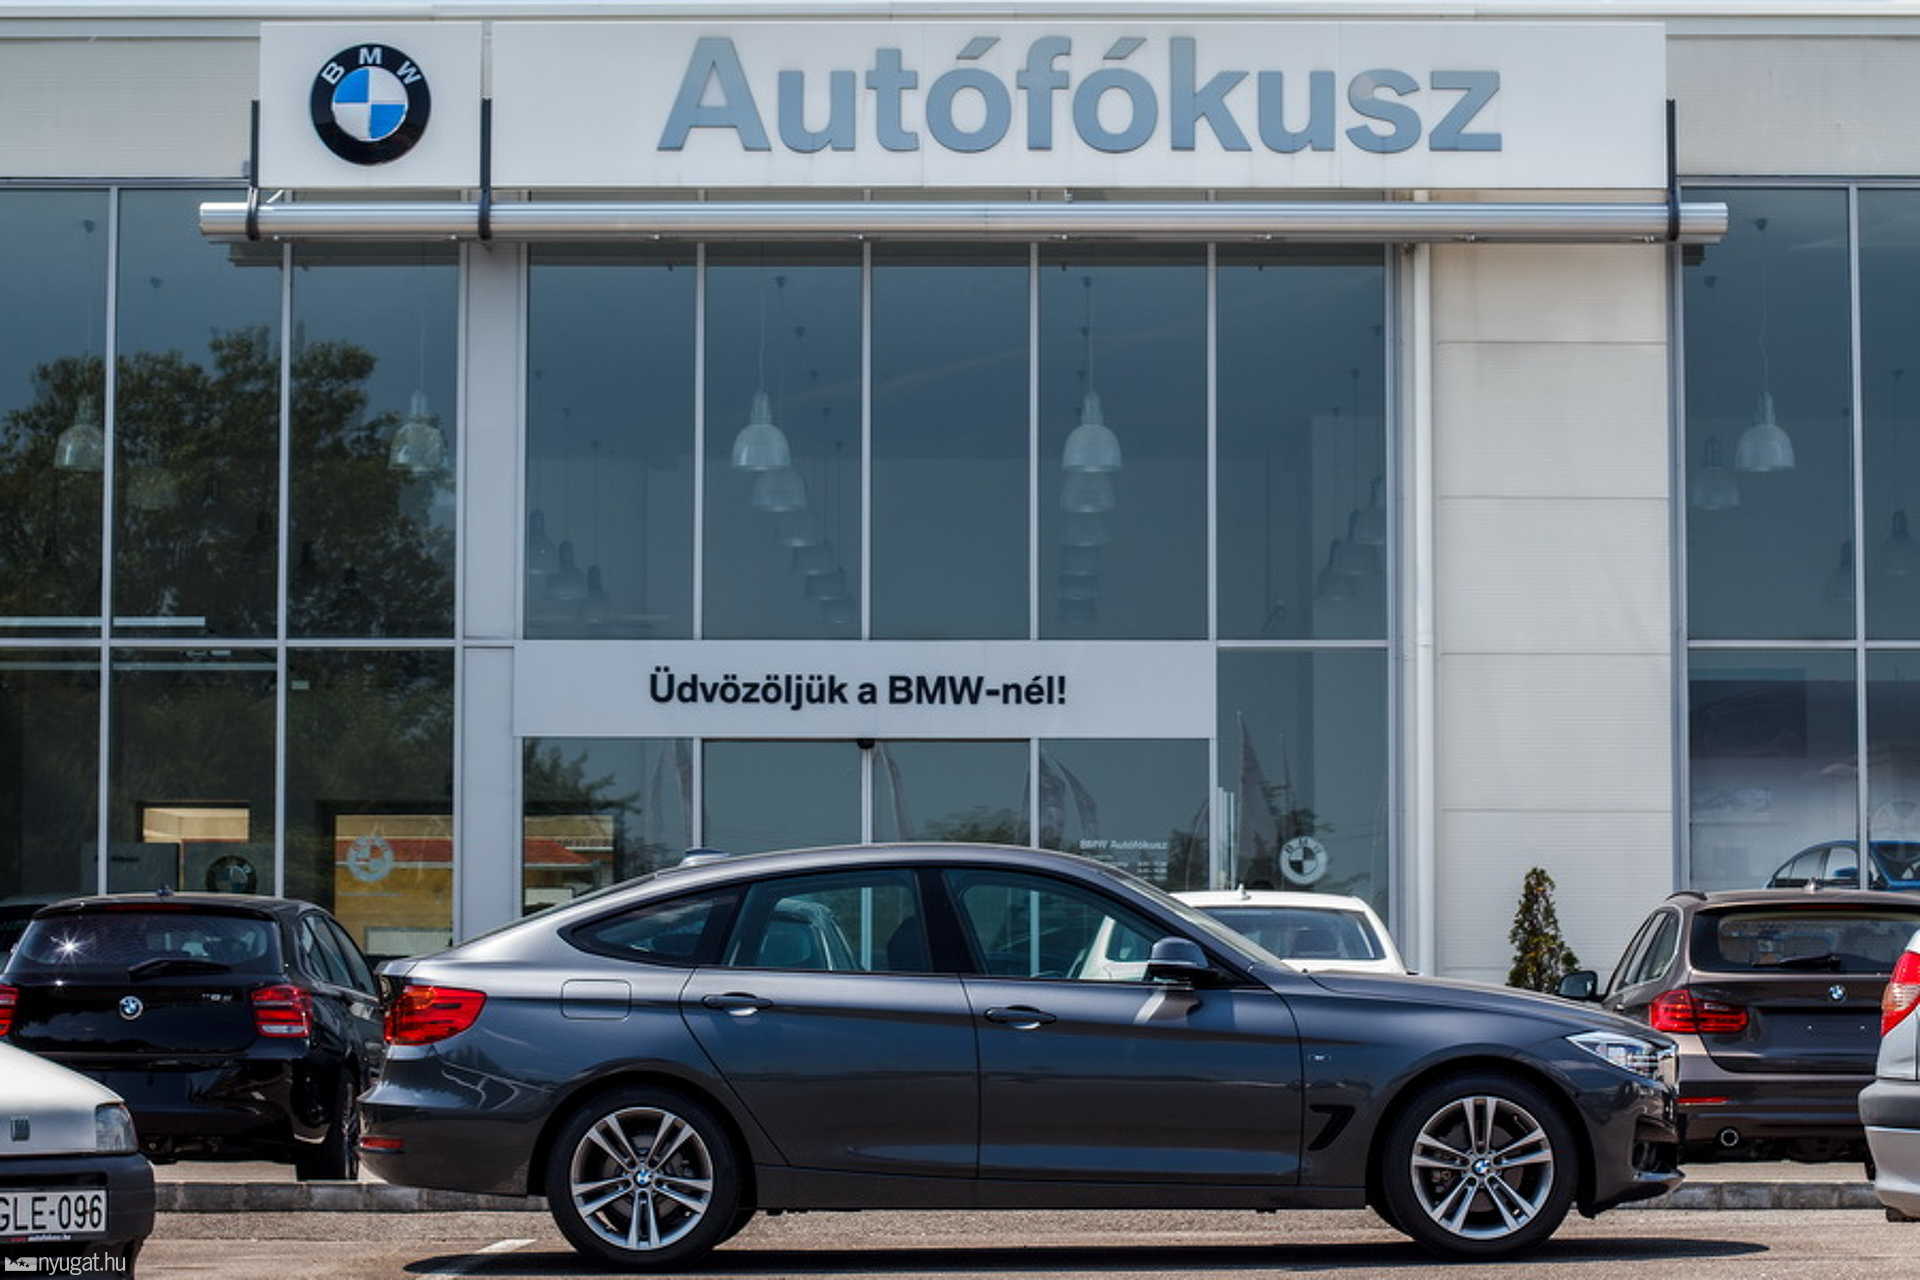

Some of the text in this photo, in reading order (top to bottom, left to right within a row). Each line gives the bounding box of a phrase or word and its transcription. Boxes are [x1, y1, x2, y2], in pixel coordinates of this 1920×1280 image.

[321, 47, 421, 84] BMW
[657, 37, 1502, 153] Autófókusz
[650, 666, 1066, 711] Üdvözöljük a BMW-nél!
[0, 1195, 102, 1231] GLE-096
